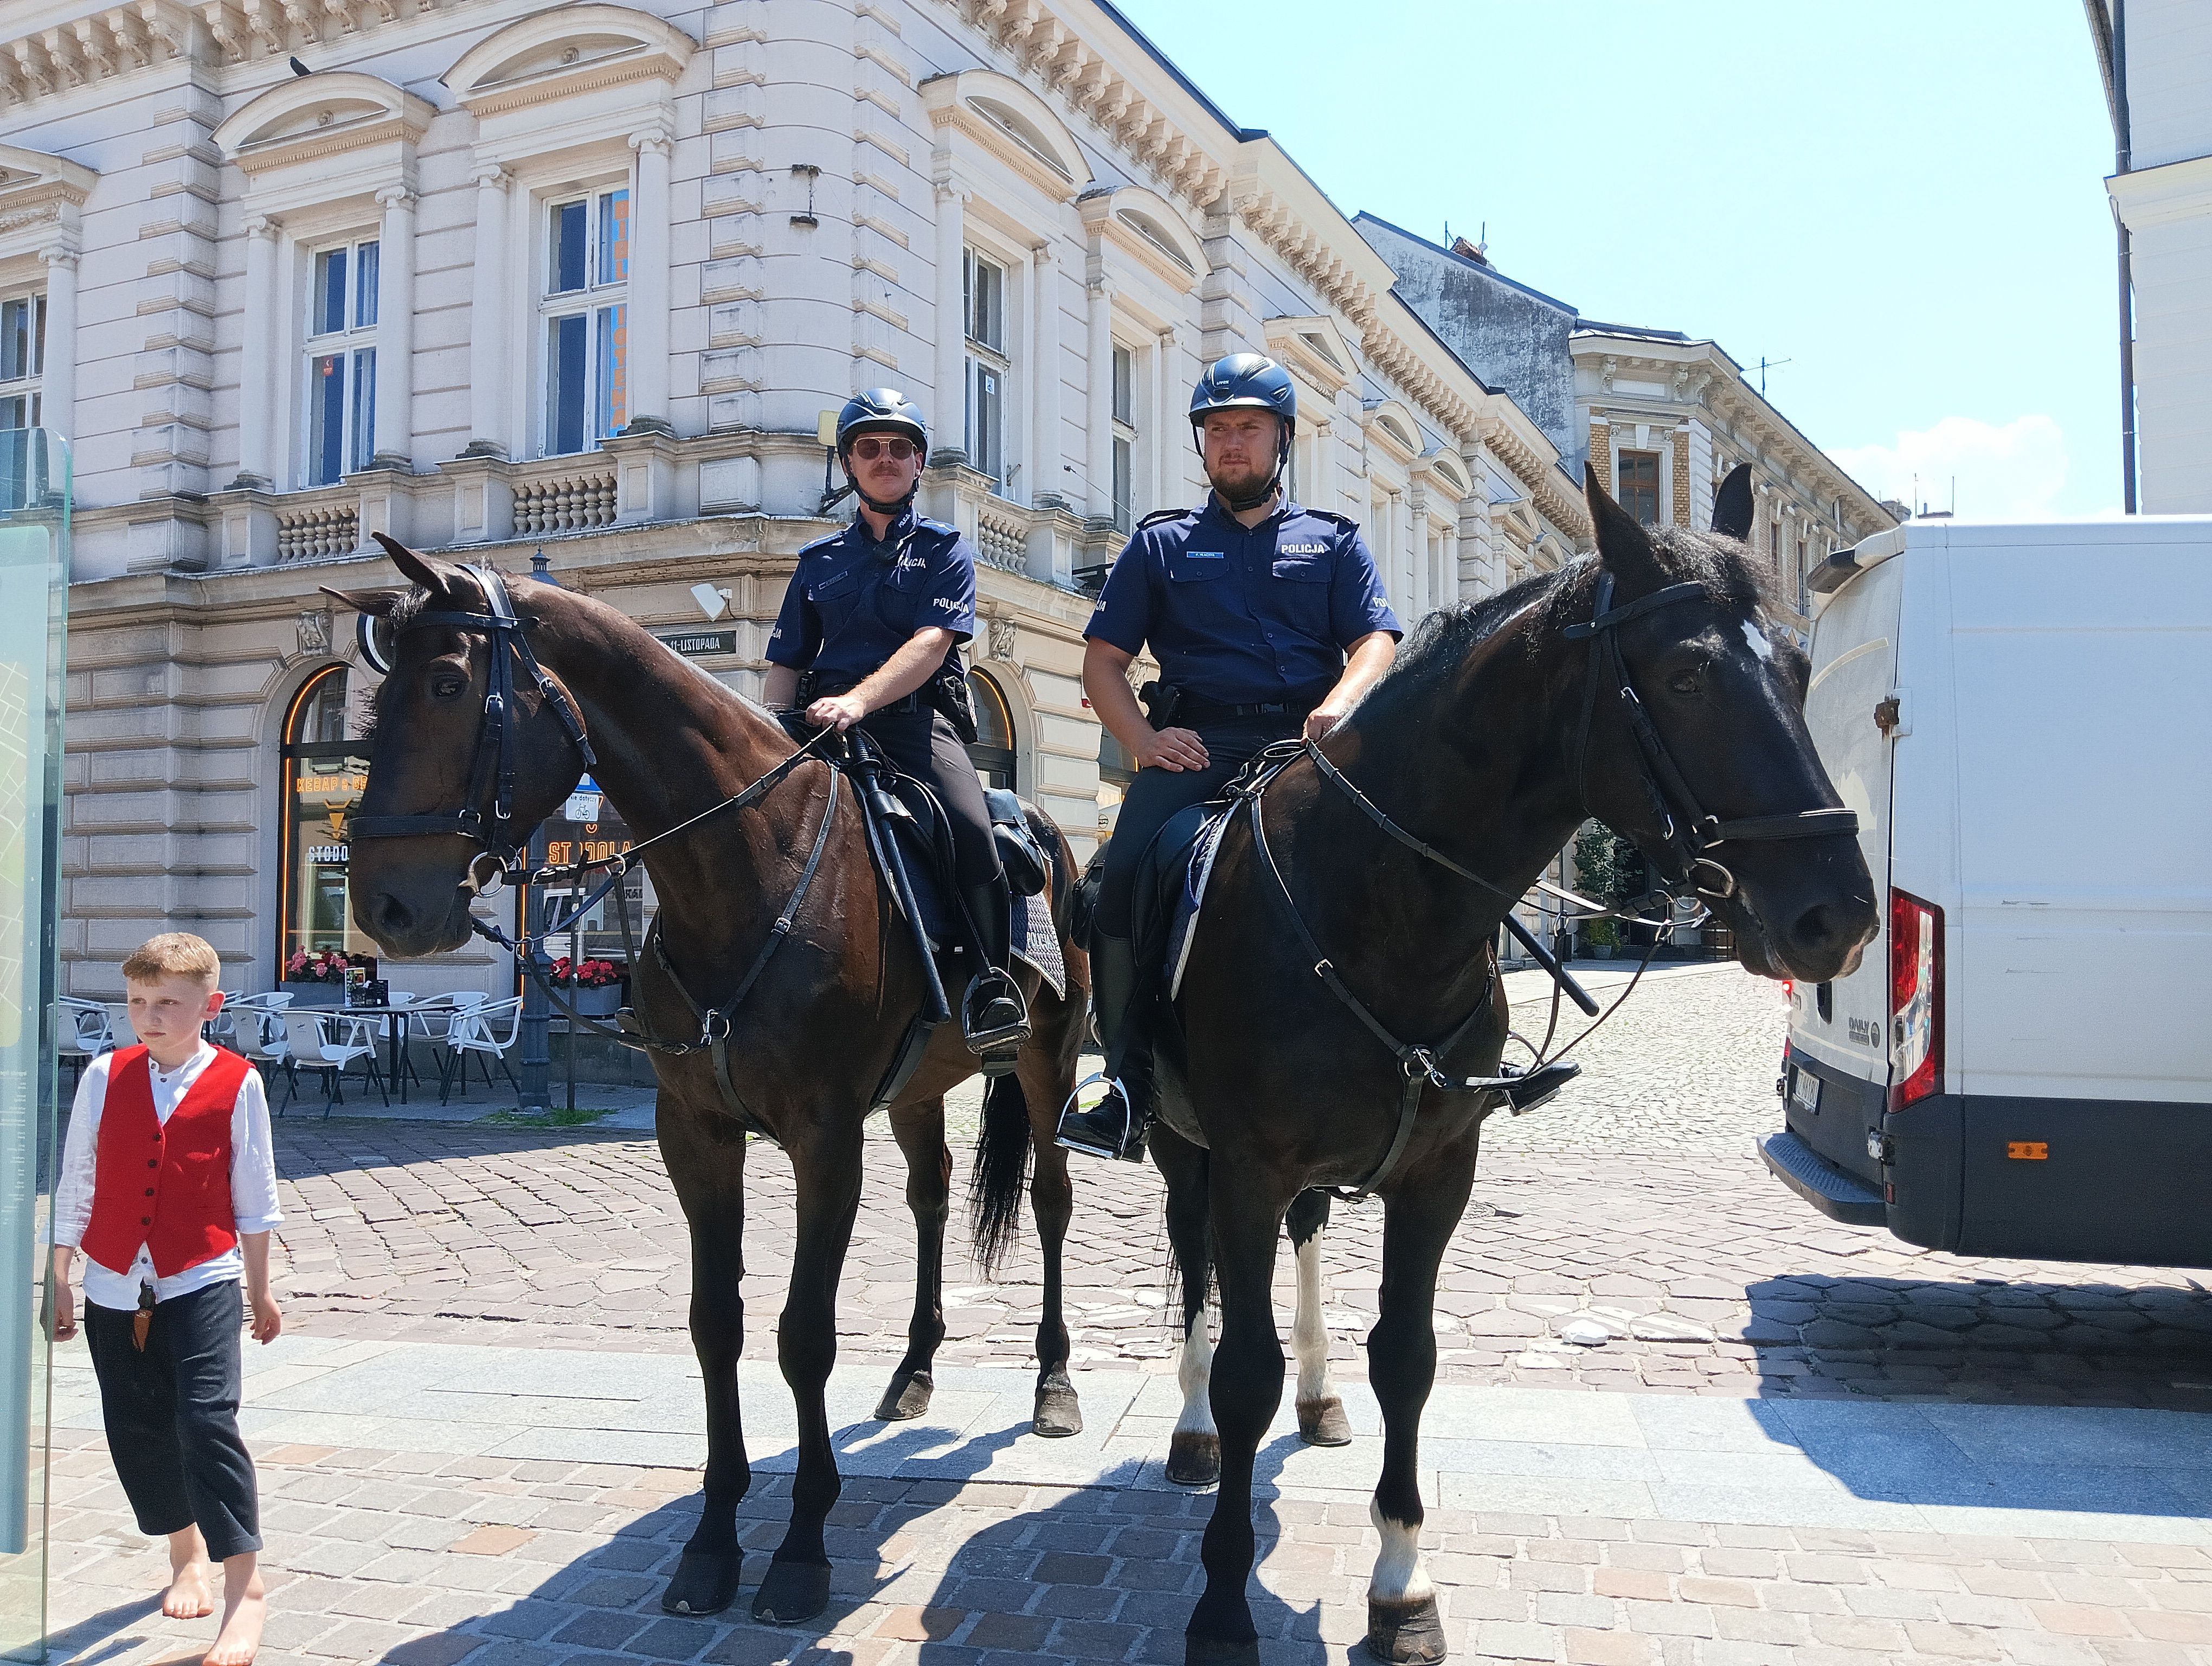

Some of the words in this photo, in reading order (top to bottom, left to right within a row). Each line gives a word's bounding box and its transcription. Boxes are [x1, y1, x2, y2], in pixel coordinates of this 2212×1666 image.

[1281, 544, 1324, 554] POLICJA
[933, 598, 969, 614] POLICJA
[297, 777, 338, 792] KEBAP
[352, 776, 368, 791] GR
[308, 845, 349, 862] STODO
[549, 841, 632, 864] STDOLA
